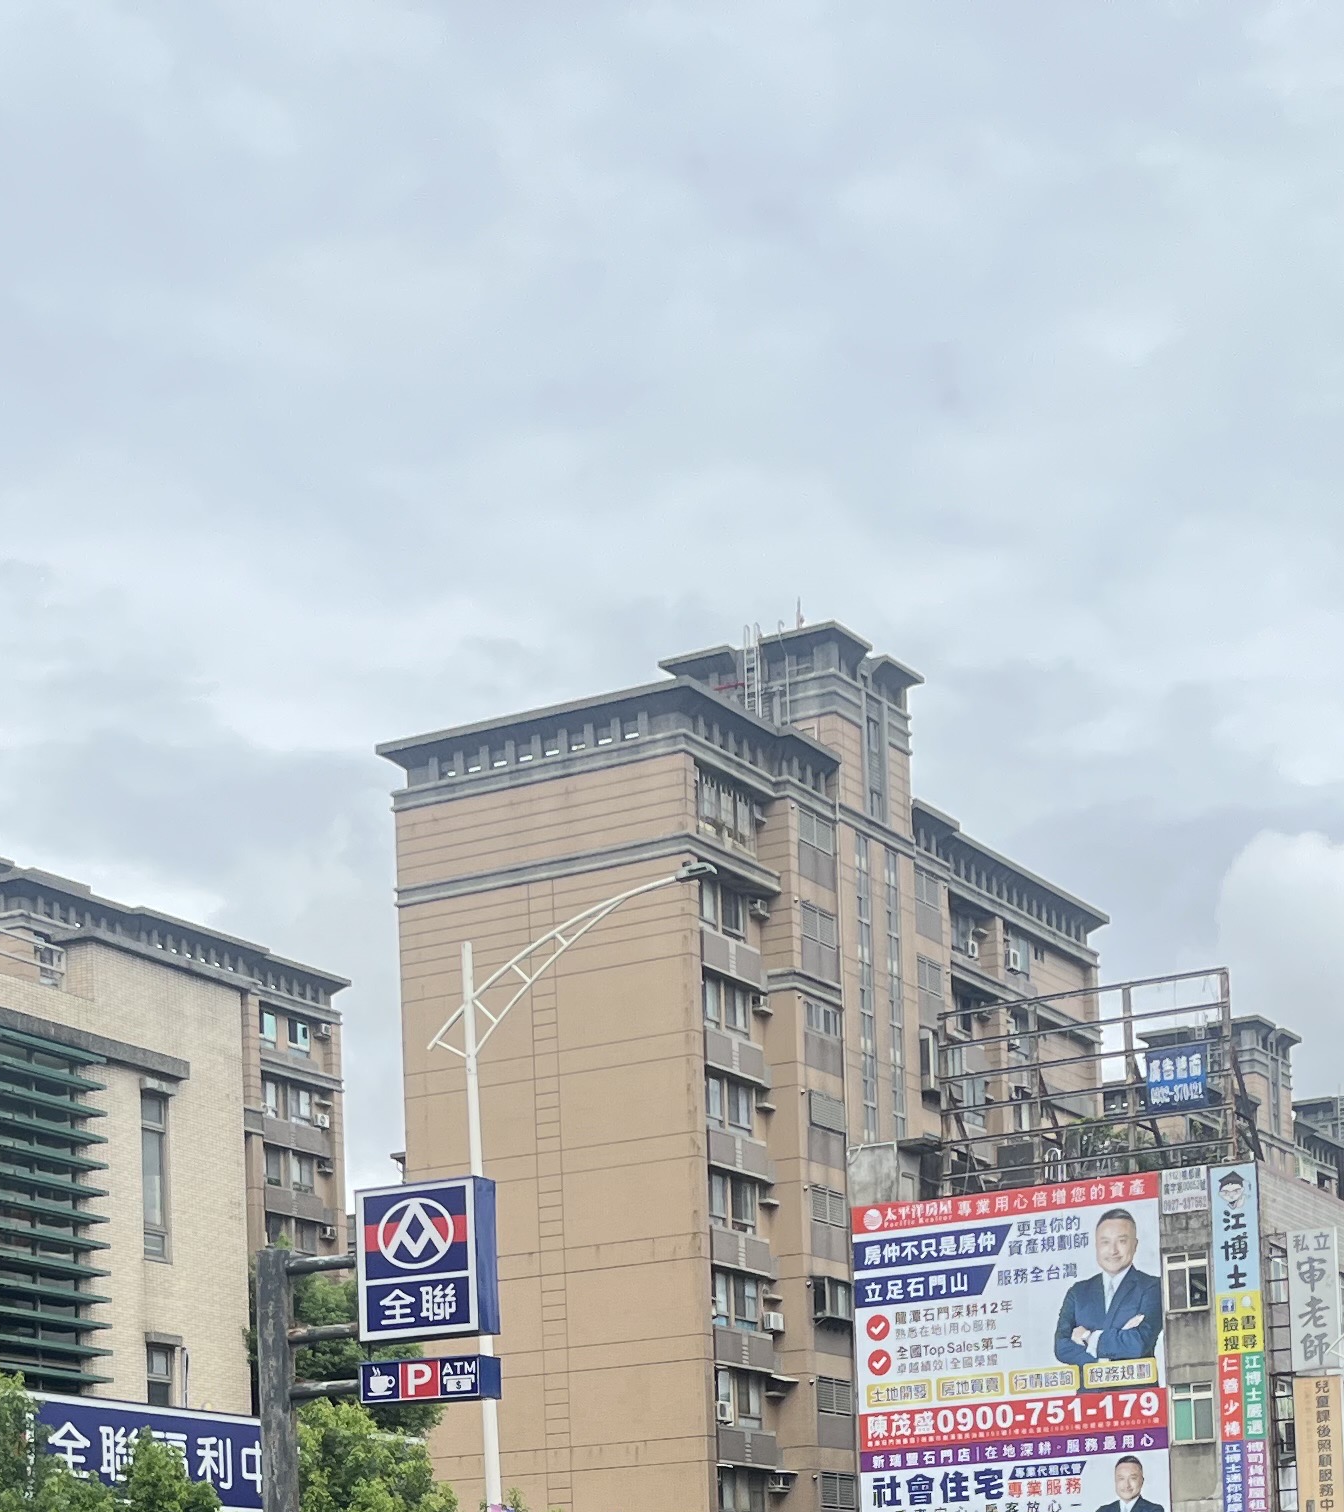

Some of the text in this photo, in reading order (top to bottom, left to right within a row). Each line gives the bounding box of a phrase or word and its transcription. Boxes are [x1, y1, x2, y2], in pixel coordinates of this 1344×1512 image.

[957, 1178, 1146, 1217] 專業用心倍增您的資產
[1017, 1215, 1081, 1238] 更是你的
[863, 1231, 997, 1266] 房仲不只是房仲
[1008, 1232, 1089, 1257] 資產規劃師
[1220, 1211, 1248, 1289] 江博士
[1292, 1233, 1330, 1254] 私立
[864, 1271, 969, 1303] 立足石門山
[997, 1262, 1078, 1287] 服務全台灣
[379, 1282, 458, 1326] 全聯
[406, 1363, 433, 1395] P
[442, 1358, 476, 1375] ATM
[866, 1391, 1160, 1440] 陳茂盛 0900-751-179
[872, 1468, 1003, 1508] 社會住宅
[1008, 1478, 1082, 1499] 專業服務
